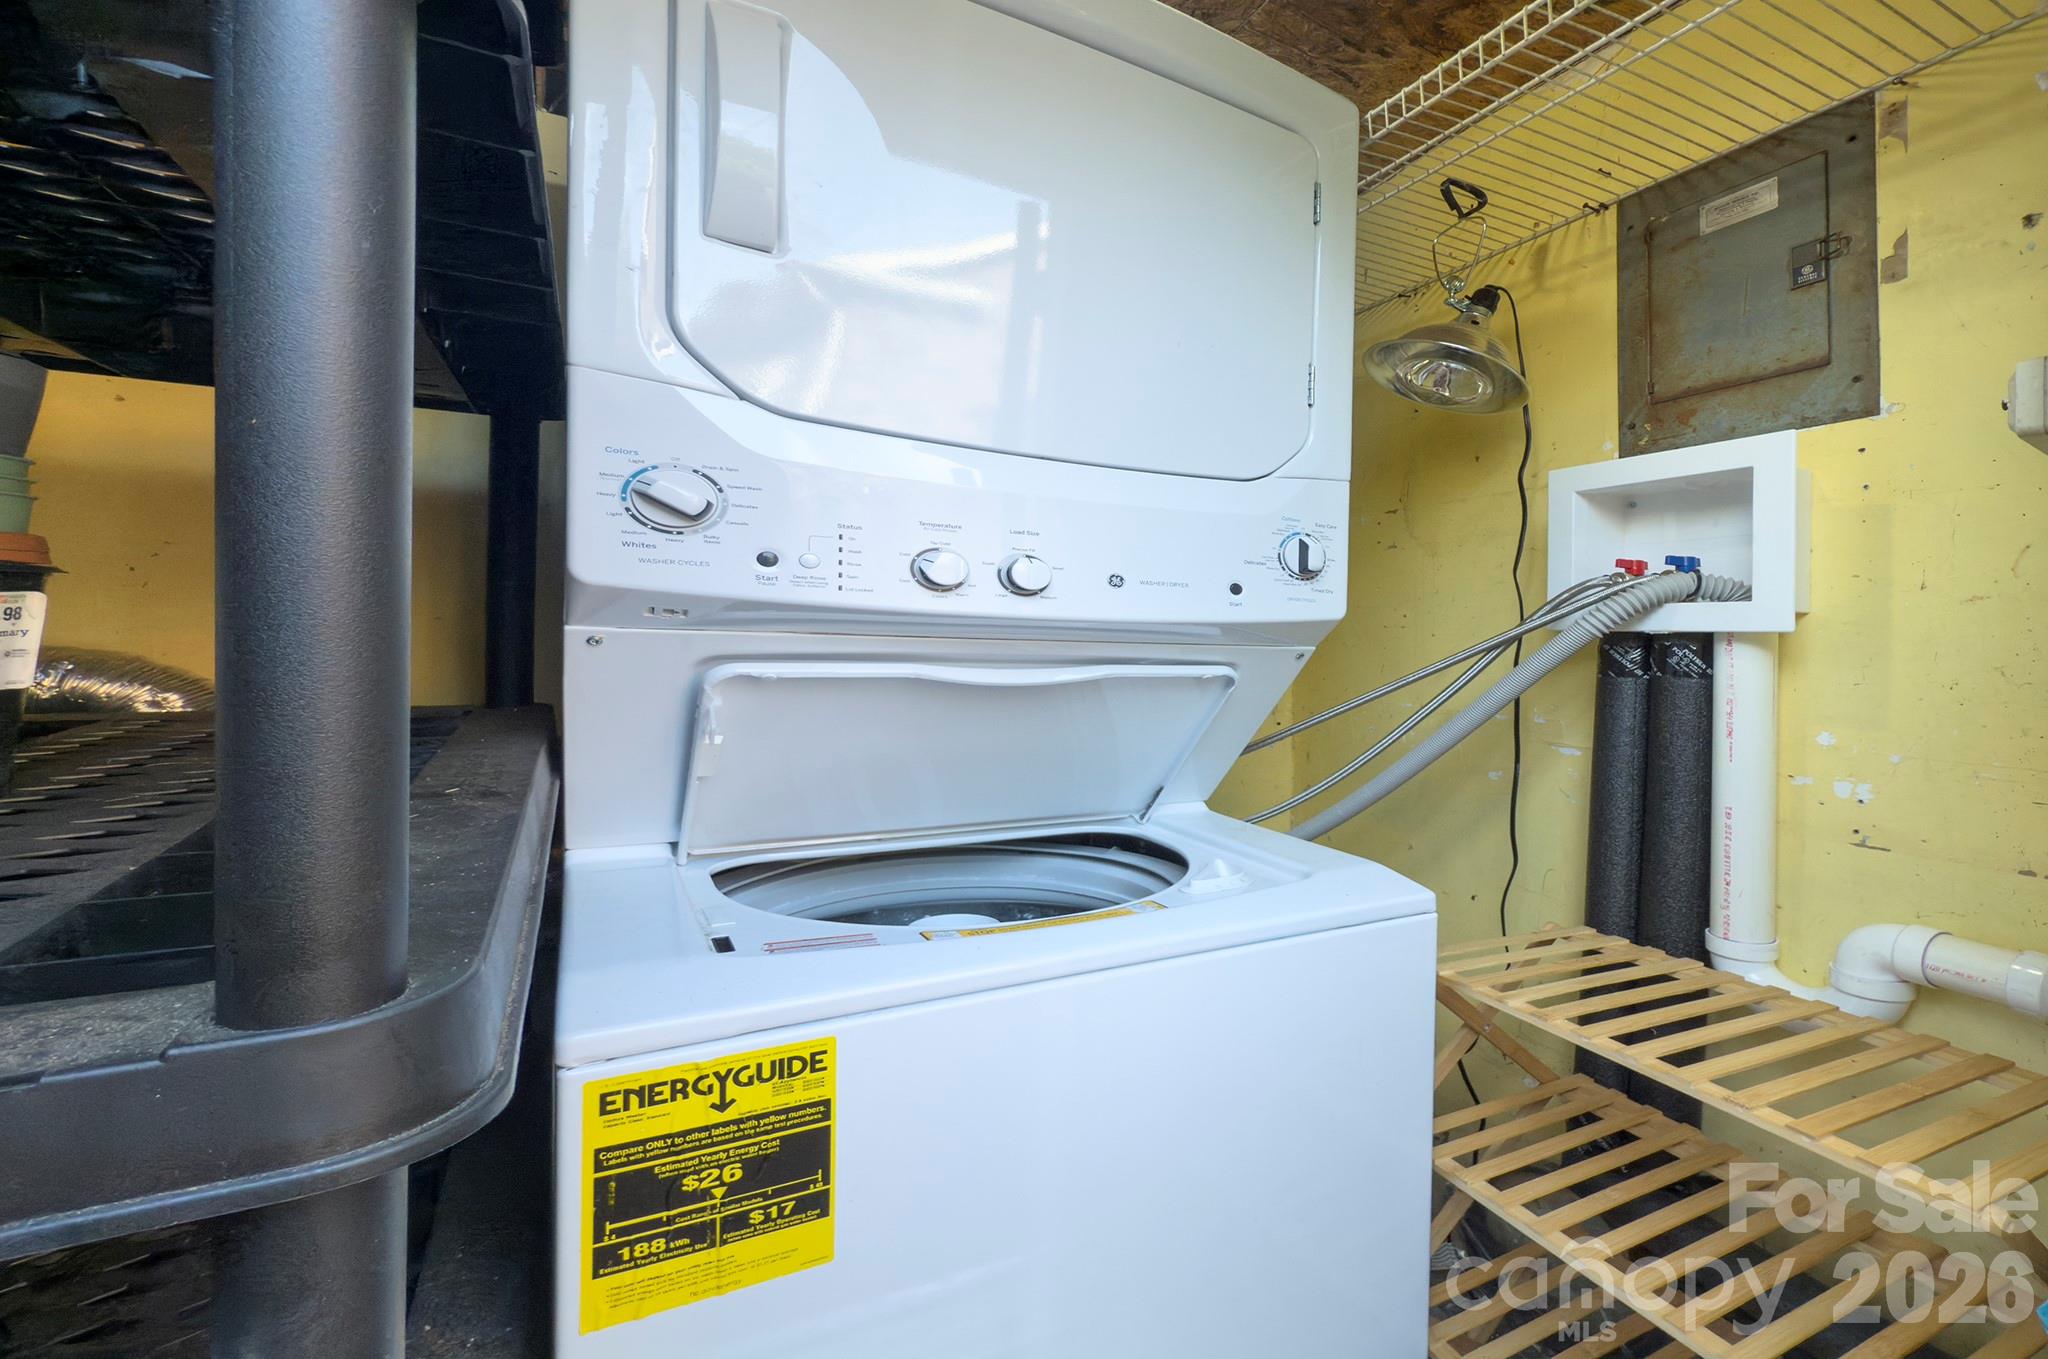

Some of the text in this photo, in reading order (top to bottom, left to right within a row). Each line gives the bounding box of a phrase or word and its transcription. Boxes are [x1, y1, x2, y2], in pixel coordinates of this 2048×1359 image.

[604, 446, 640, 456] Colors
[837, 522, 863, 530] Status
[919, 520, 962, 530] Temperature
[621, 540, 657, 550] Whites
[638, 557, 711, 568] WASHER CYCLES
[755, 574, 778, 582] Start
[3, 606, 23, 621] 98
[598, 1049, 829, 1118] ENERGYGUIDE
[599, 1103, 826, 1161] Compare ONLY to other labels with yellow numbers.
[645, 1146, 669, 1157] yellow
[654, 1138, 780, 1174] Estimated Yearly Energy Cost
[681, 1161, 743, 1193] $26
[748, 1199, 796, 1225] $17
[616, 1236, 690, 1263] 188 kWh
[599, 1240, 707, 1276] Estimated Yearly Electricity Use
